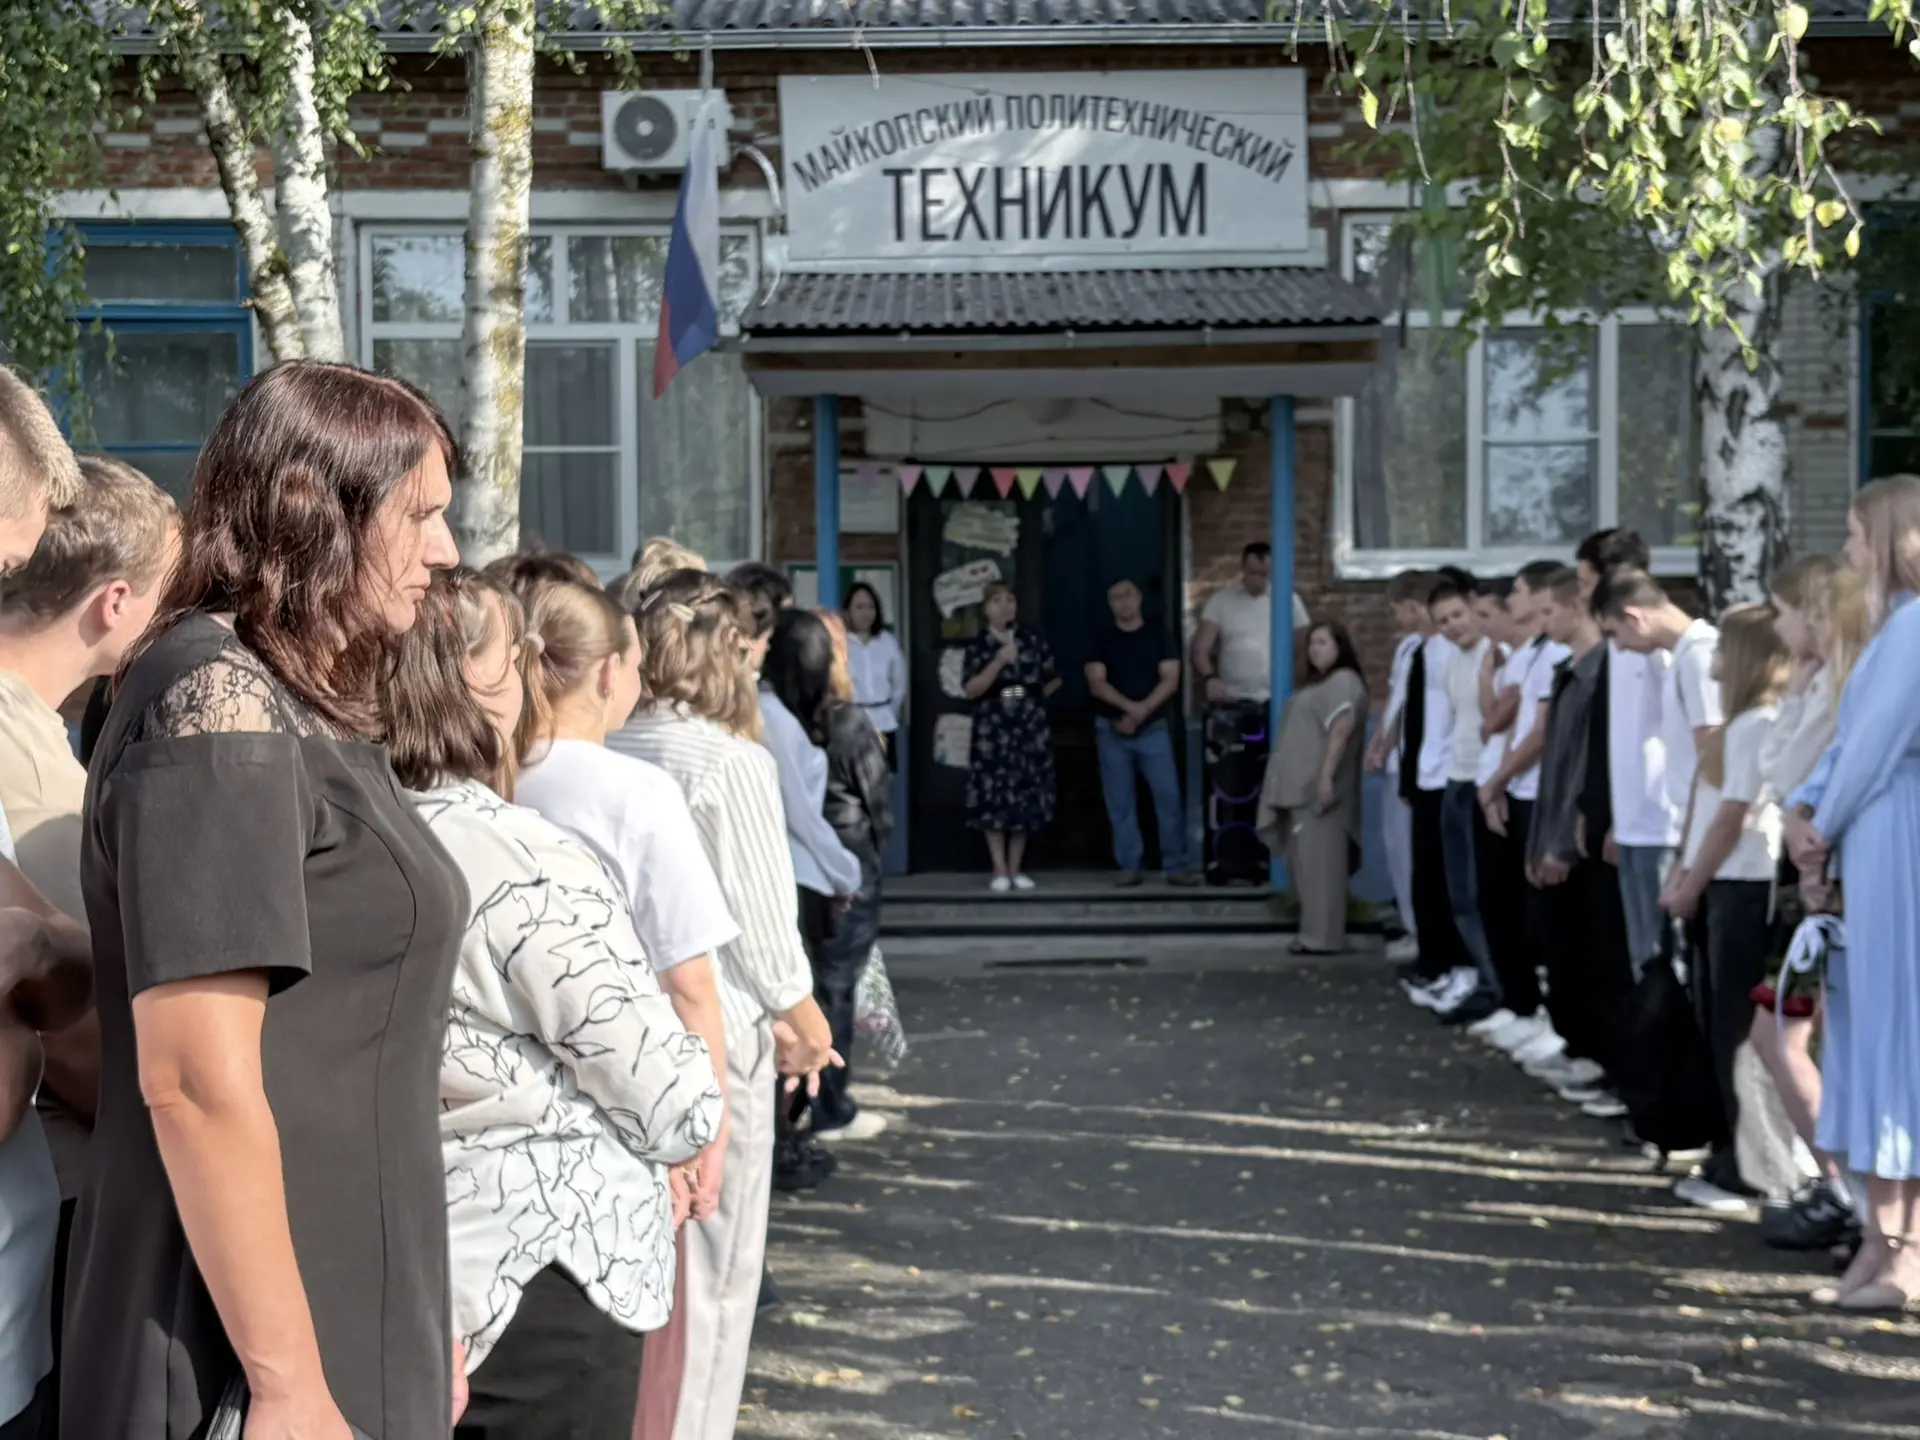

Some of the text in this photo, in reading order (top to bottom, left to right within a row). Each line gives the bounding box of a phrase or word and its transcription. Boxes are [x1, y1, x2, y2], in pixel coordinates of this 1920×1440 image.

[791, 89, 1297, 193] МАЙКОПСКИЙ ПОЛИТЕХНИЧЕСКИЙ
[882, 162, 1207, 242] ТЕХНИКУМ
